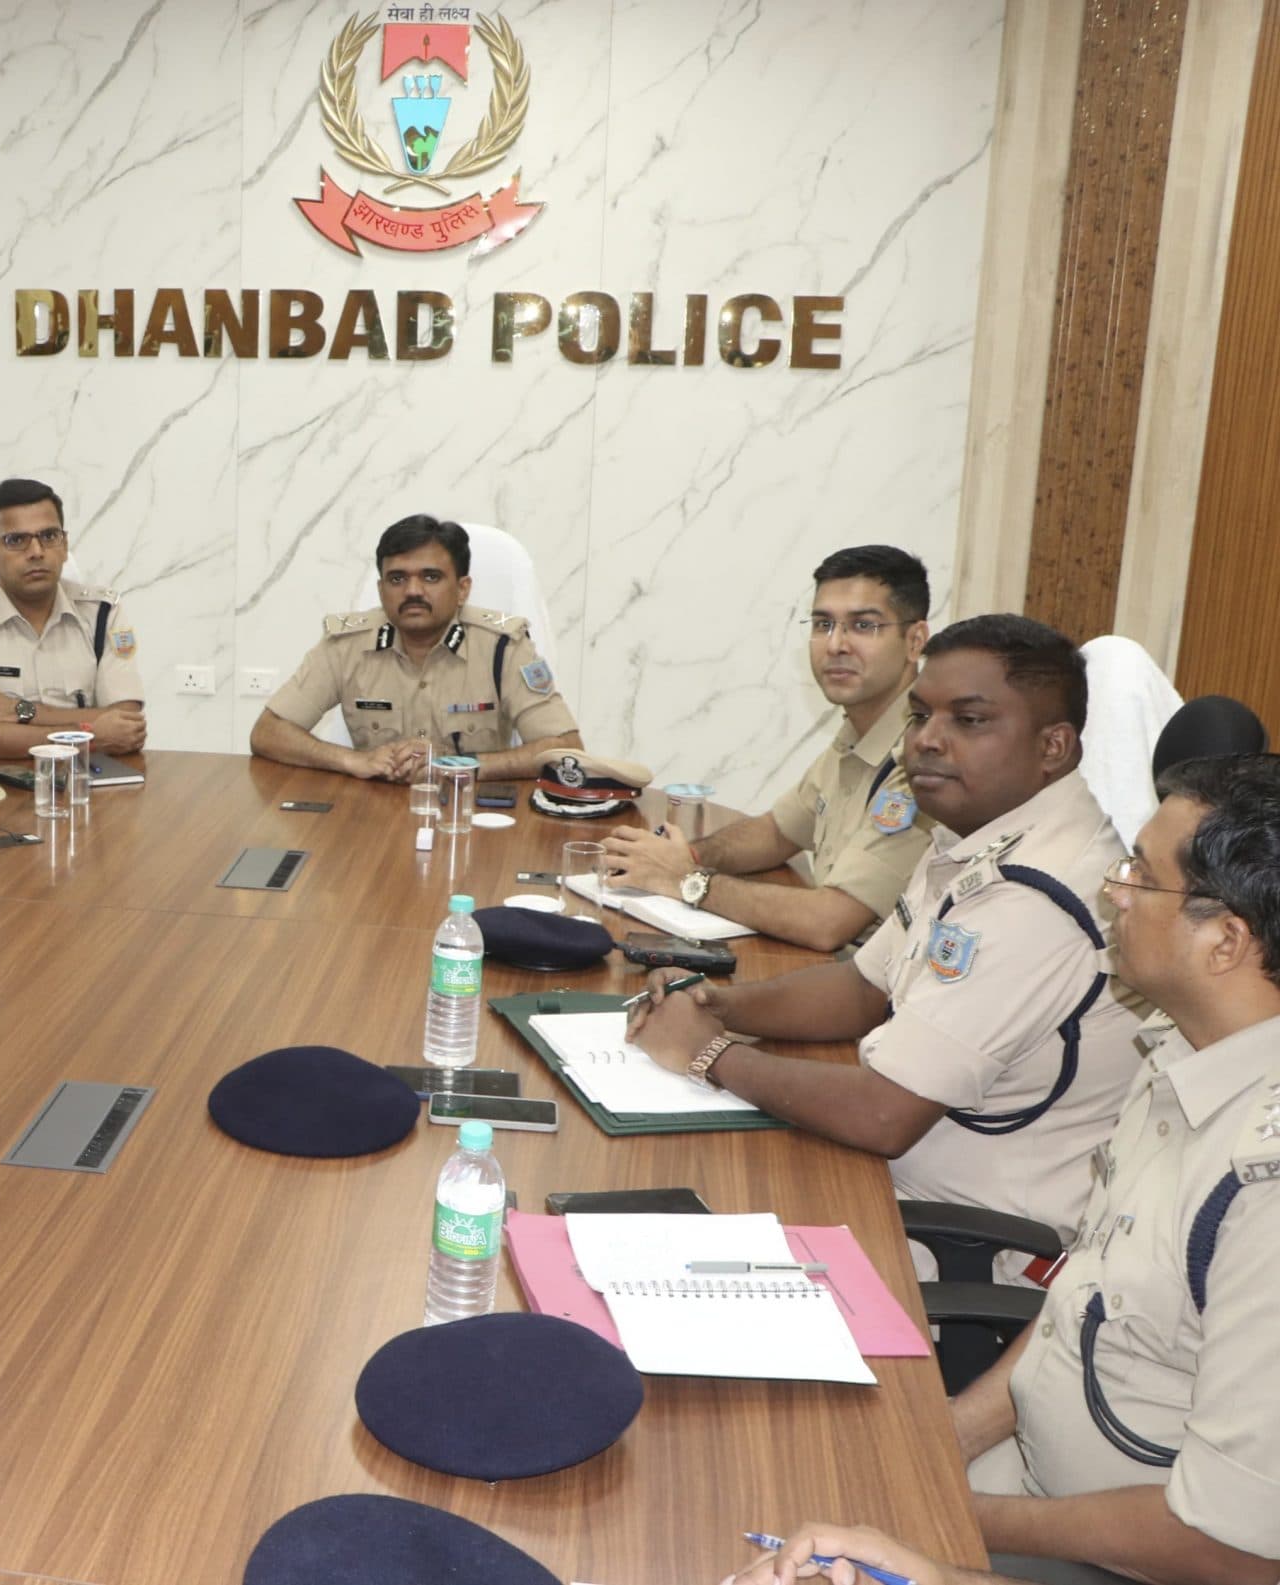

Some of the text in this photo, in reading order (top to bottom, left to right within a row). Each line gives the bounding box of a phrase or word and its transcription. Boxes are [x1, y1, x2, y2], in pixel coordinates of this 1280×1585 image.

[387, 2, 470, 21] सेवा ही लक्ष्य
[353, 200, 480, 243] झारखण्ड पुलिस
[15, 288, 845, 369] DHANBAD POLICE
